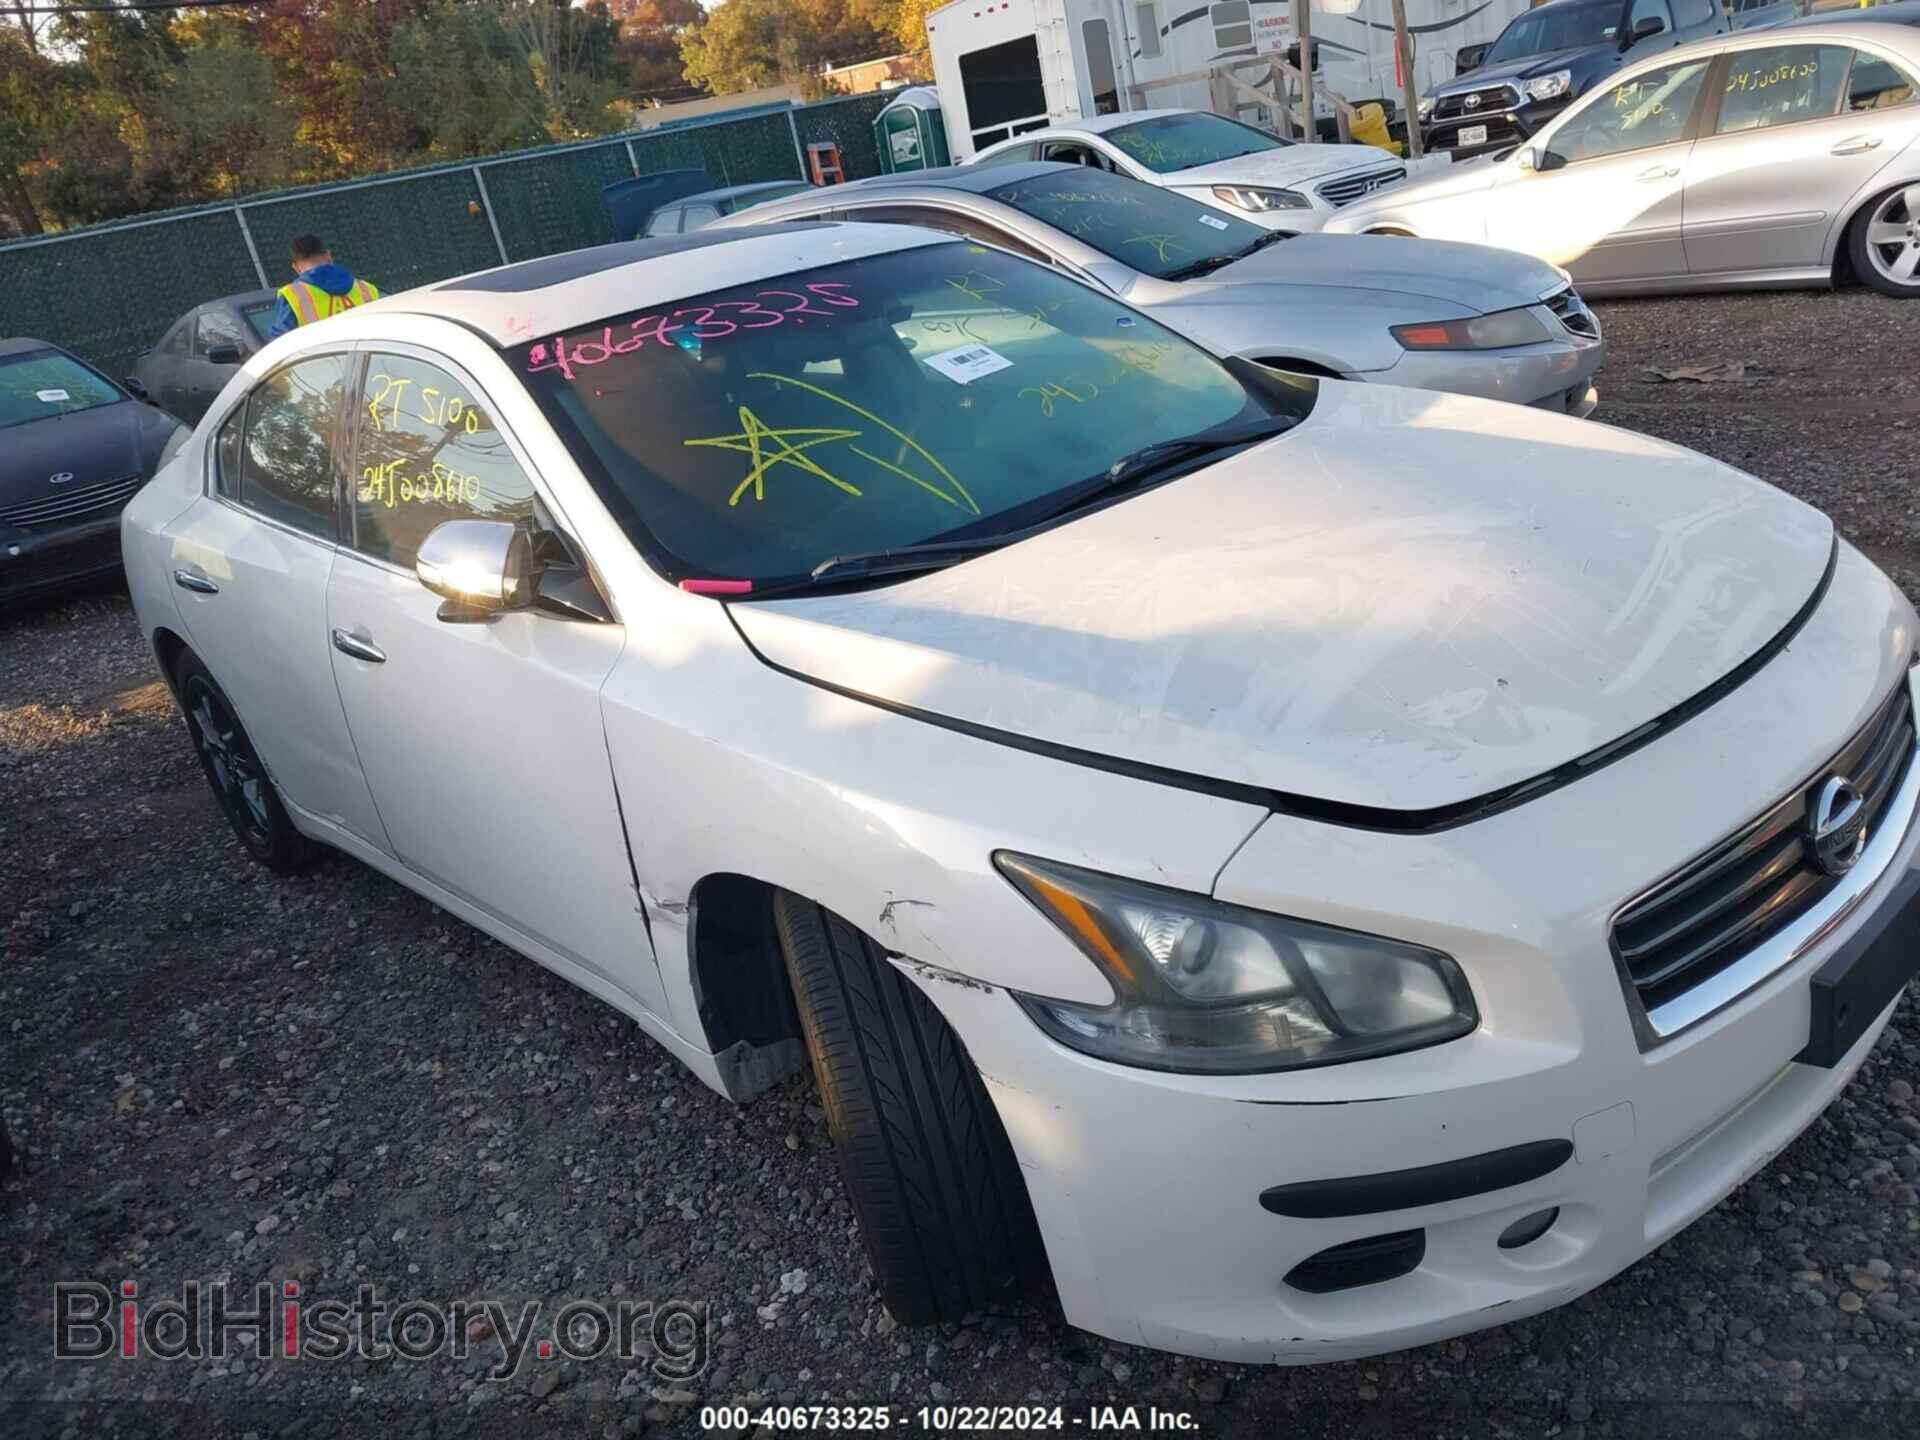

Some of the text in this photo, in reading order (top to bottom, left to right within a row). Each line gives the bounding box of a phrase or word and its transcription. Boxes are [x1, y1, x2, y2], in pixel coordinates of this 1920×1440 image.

[528, 283, 860, 380] 40673325
[369, 374, 478, 434] RT 5100
[357, 458, 480, 508] 24J008610
